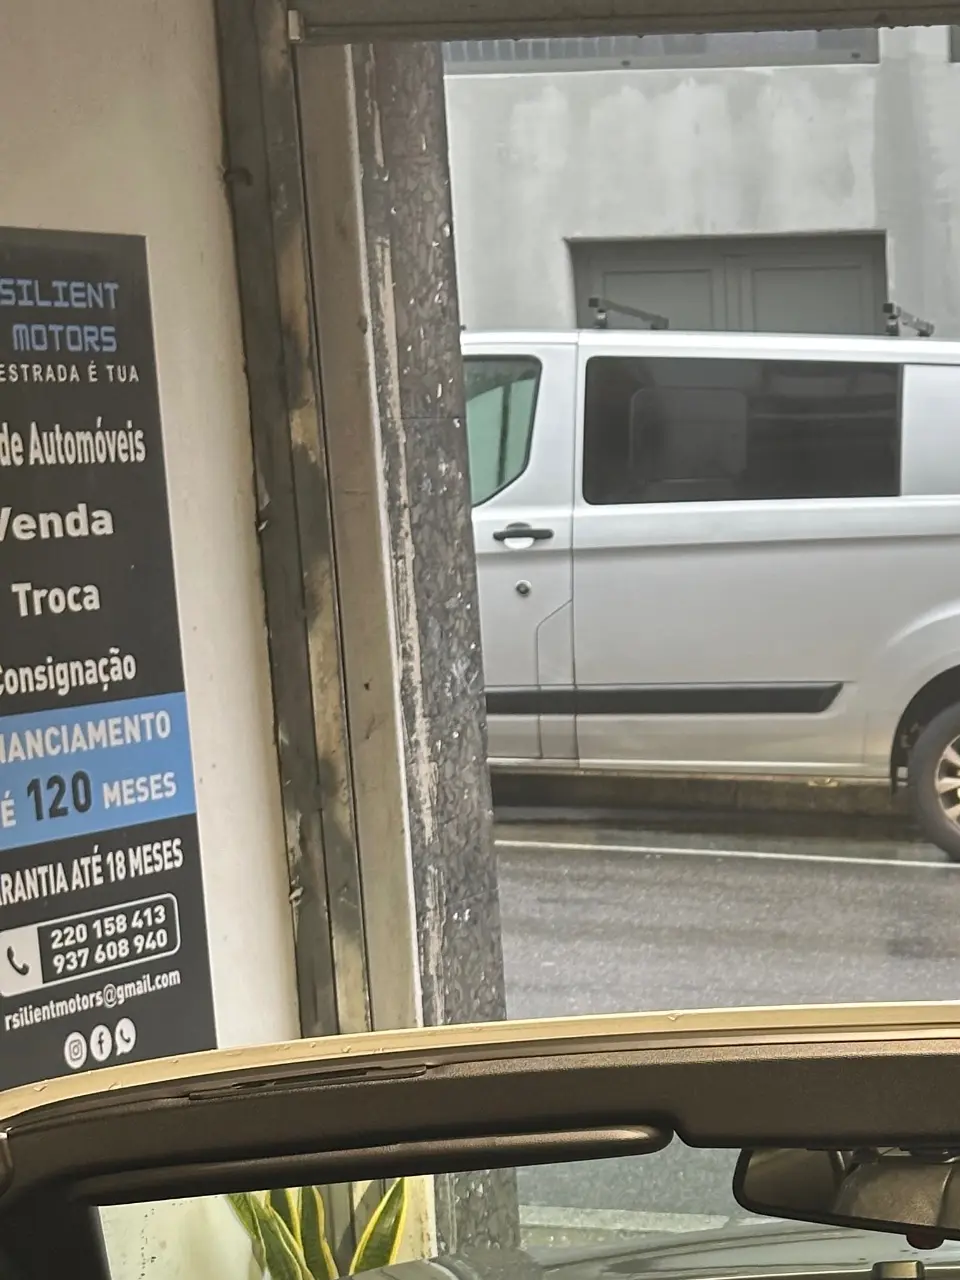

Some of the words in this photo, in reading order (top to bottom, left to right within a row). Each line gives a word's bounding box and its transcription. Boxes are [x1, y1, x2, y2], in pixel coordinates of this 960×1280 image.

[13, 324, 117, 352] MOTORS
[0, 364, 80, 382] ESTRADA
[88, 360, 98, 382] É
[106, 364, 140, 382] TUA
[0, 422, 24, 466] de
[29, 416, 146, 465] Automóveis
[11, 582, 100, 616] Troca
[27, 769, 92, 821] 120
[103, 772, 177, 809] MESES
[0, 862, 69, 906] RANTIA
[72, 844, 104, 891] ATÉ
[106, 850, 127, 883] 18
[129, 838, 184, 878] MESES
[51, 923, 88, 949] 220
[93, 914, 128, 939] 158
[132, 904, 166, 929] 413
[53, 948, 90, 974] 937
[95, 938, 130, 964] 608
[134, 928, 168, 954] 940
[4, 970, 182, 1031] rsilientmotors@gmail.com
